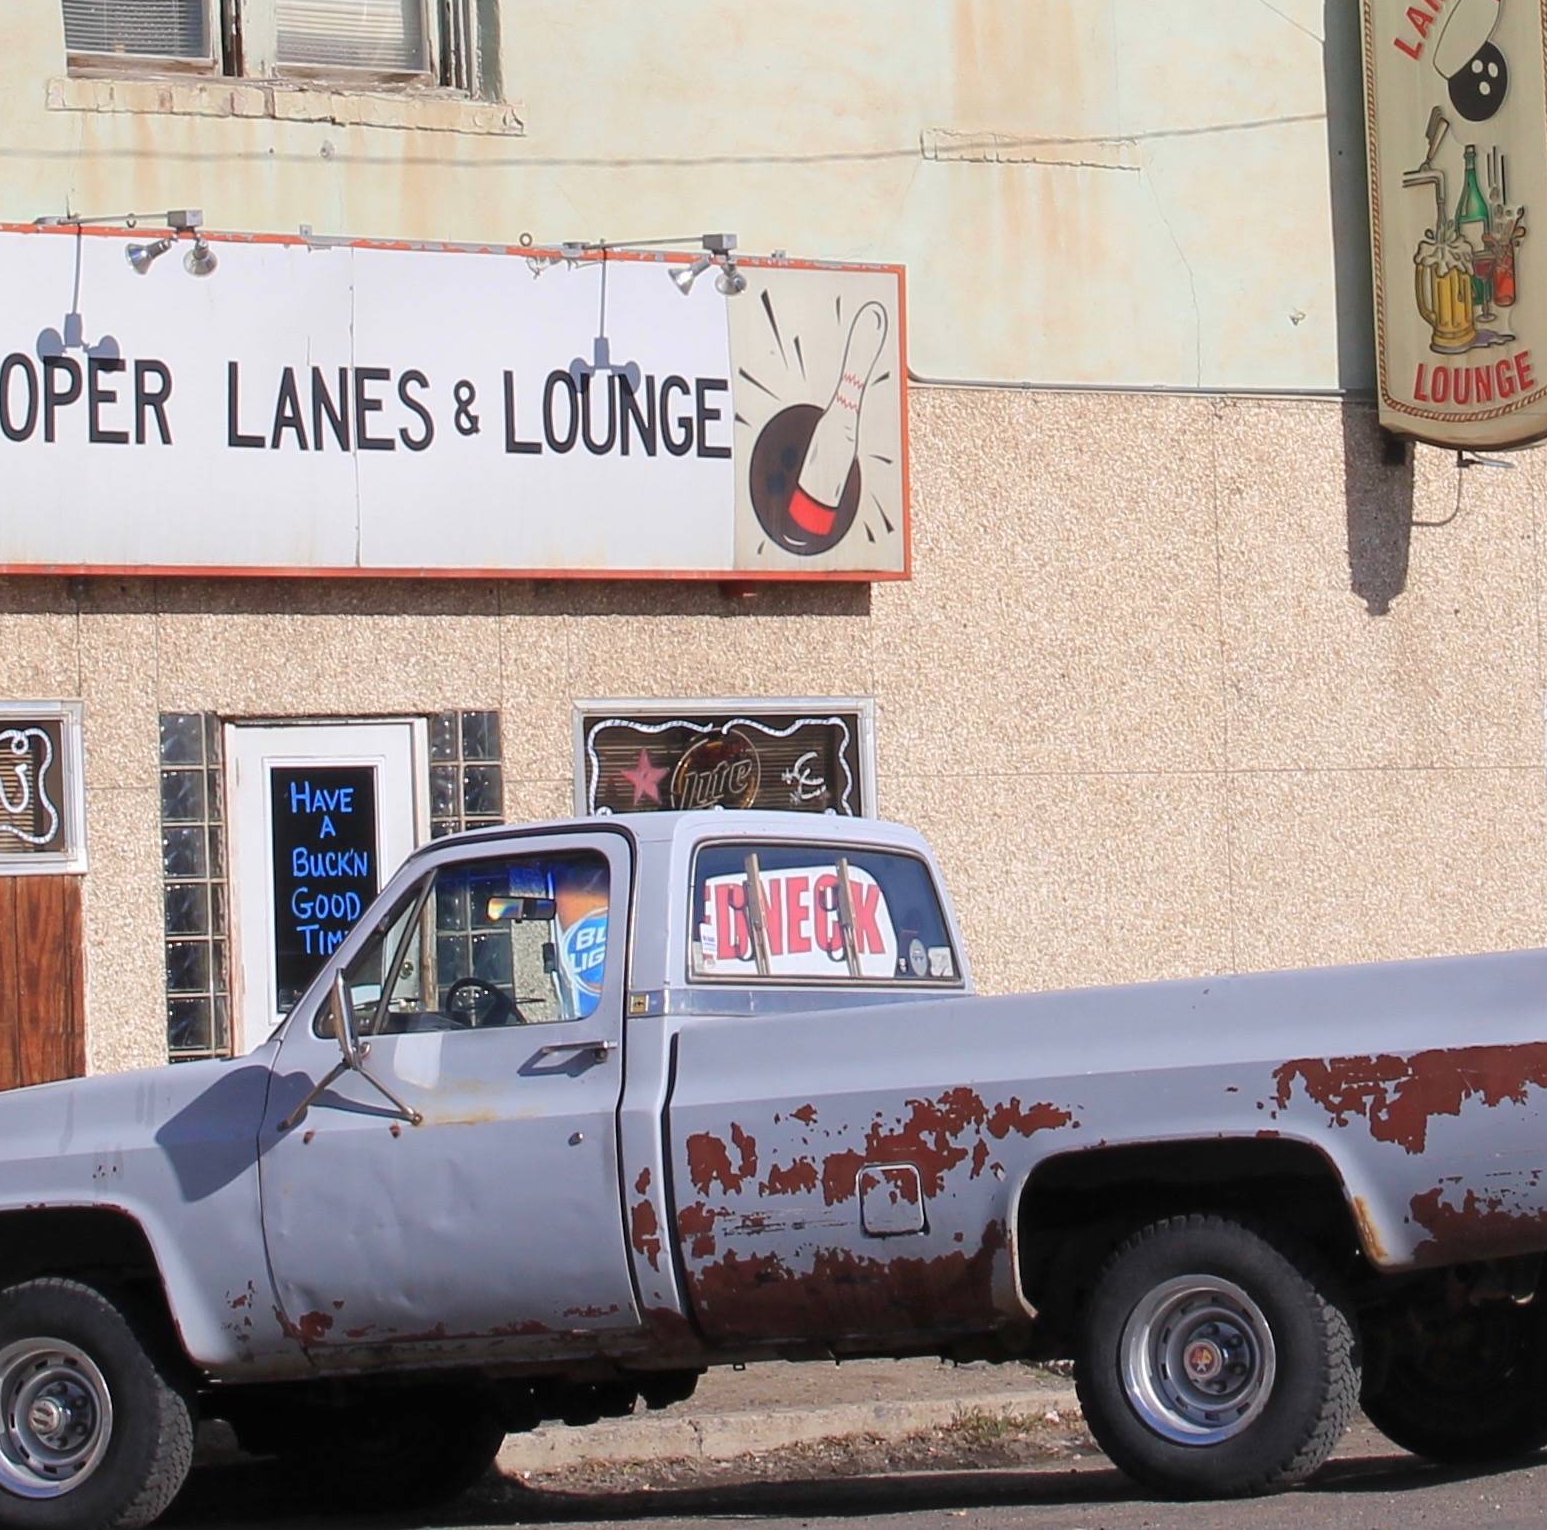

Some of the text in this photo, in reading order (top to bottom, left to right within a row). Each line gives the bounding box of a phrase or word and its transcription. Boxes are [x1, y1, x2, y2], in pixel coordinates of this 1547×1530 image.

[1412, 350, 1536, 405] LOUNGE
[228, 361, 434, 452] LANES
[453, 379, 480, 436] &
[504, 369, 732, 458] LOUNGE
[290, 781, 354, 813] HAVE
[319, 815, 336, 839] A
[292, 886, 361, 921] GOOD
[296, 924, 350, 956] TIM
